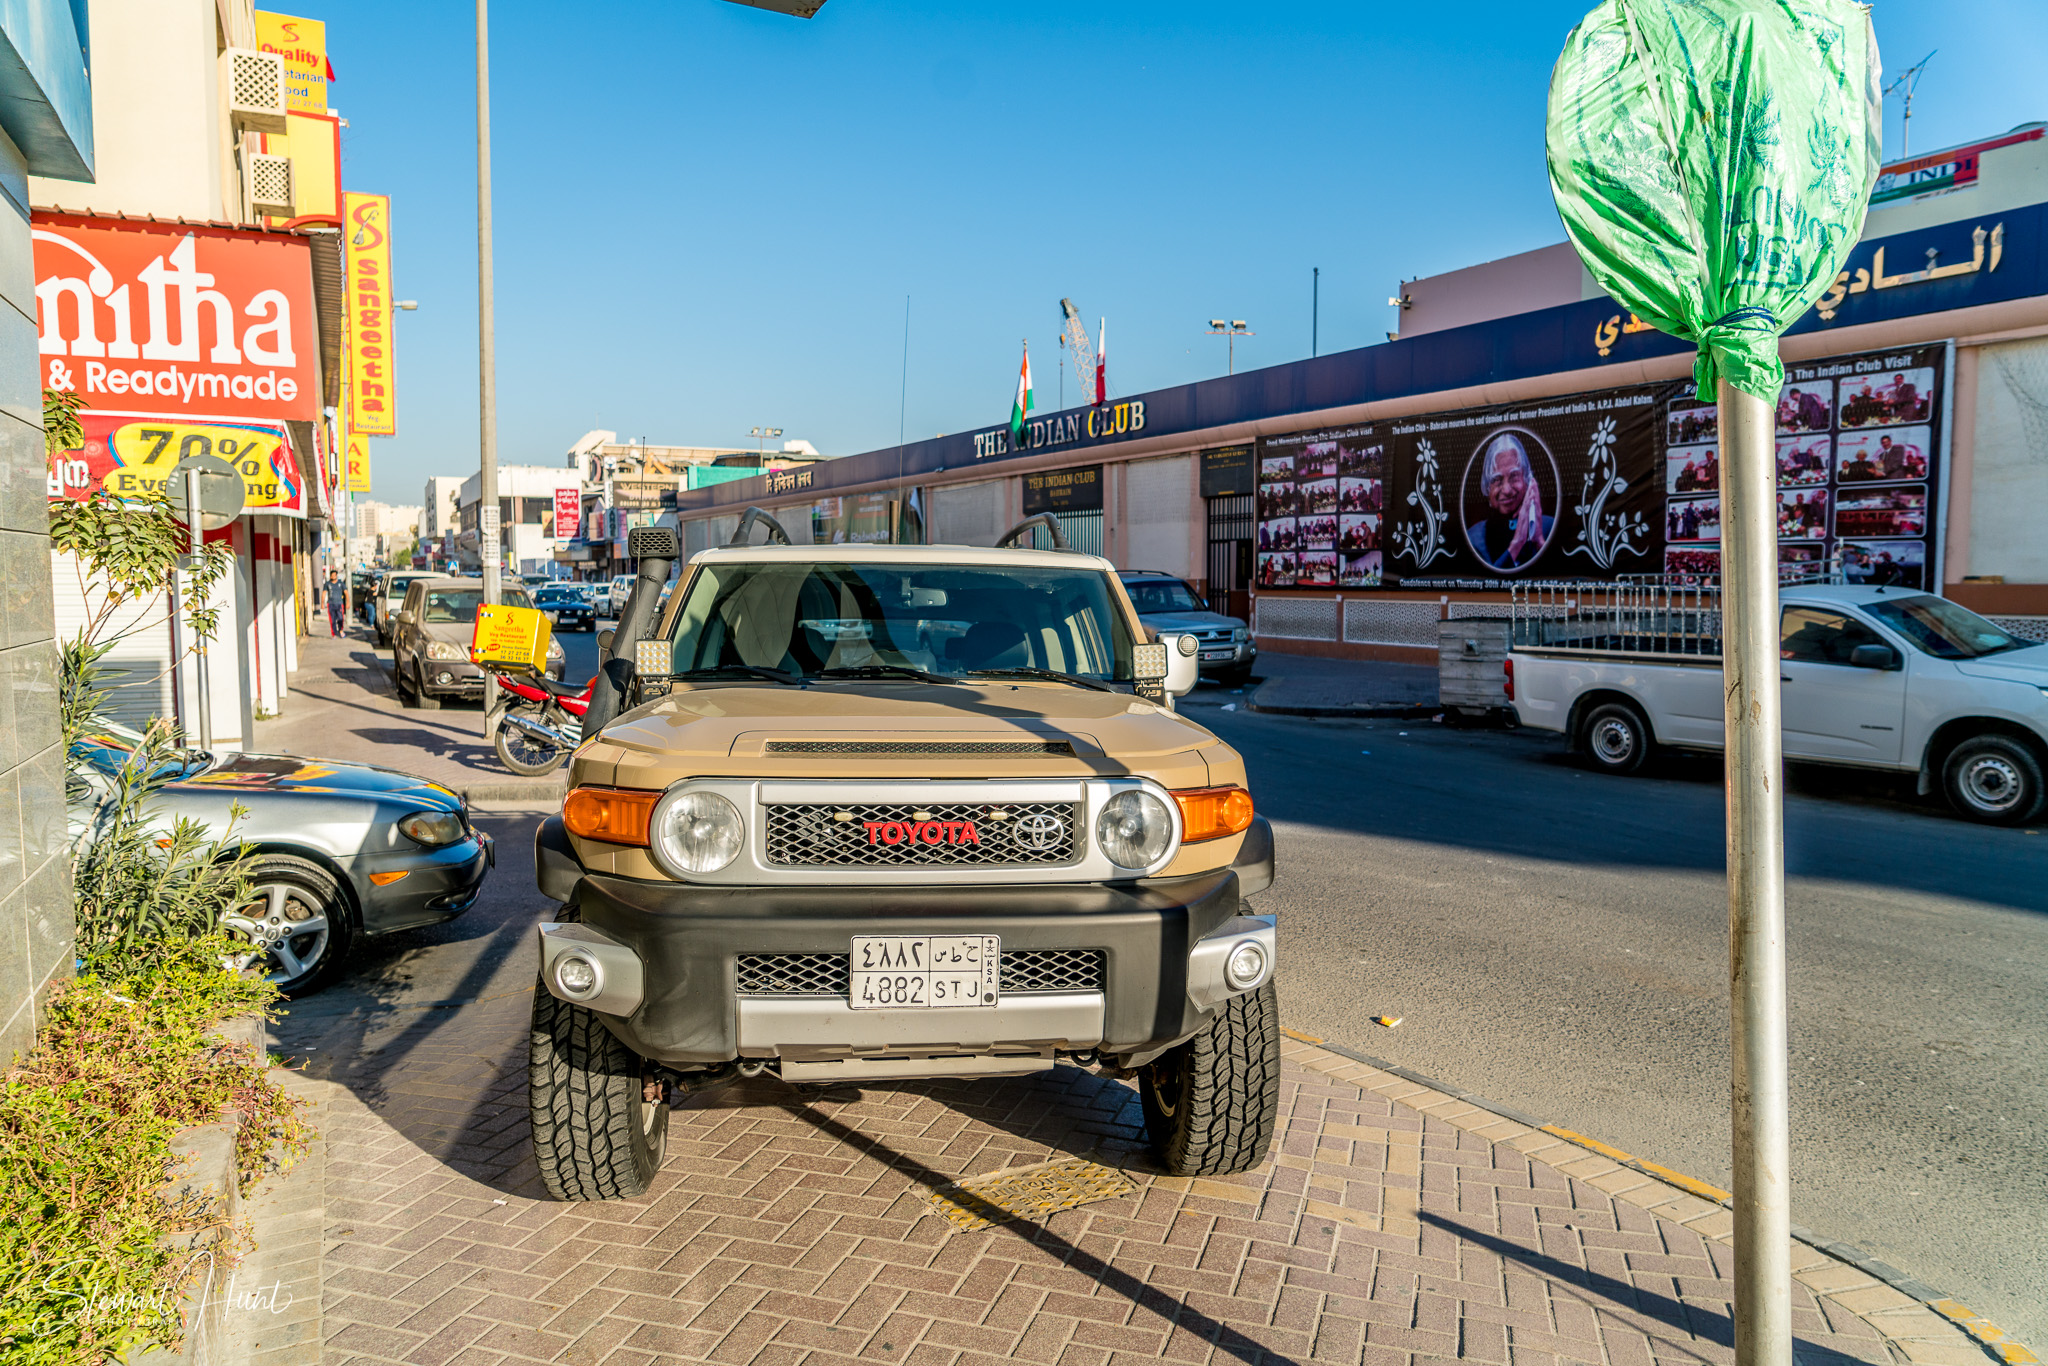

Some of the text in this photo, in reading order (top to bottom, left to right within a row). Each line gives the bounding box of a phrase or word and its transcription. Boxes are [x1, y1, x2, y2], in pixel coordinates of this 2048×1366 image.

[261, 43, 320, 68] Quality
[284, 69, 324, 83] etarian
[285, 87, 308, 97] ood
[1910, 157, 1933, 170] THE
[1910, 158, 1979, 185] INDI
[35, 230, 297, 369] nitha
[1795, 369, 1815, 380] The
[1818, 364, 1853, 377] Indian
[1855, 359, 1882, 373] Club
[1885, 355, 1912, 369] Visit
[48, 359, 298, 404] & Readymade
[1392, 427, 1400, 435] The
[1400, 426, 1414, 434] Indian
[1415, 424, 1426, 433] Club
[1430, 421, 1448, 431] Bahrain
[1448, 420, 1466, 428] mourns
[1467, 418, 1475, 426] the
[1475, 416, 1485, 425] sad
[1485, 415, 1503, 424] demise
[1519, 410, 1537, 419] former
[1538, 406, 1564, 417] President
[1565, 405, 1572, 414] of
[1572, 403, 1587, 413] India
[1588, 402, 1596, 411] Dr.
[1597, 400, 1614, 411] A.P.J.
[1614, 397, 1632, 408] Abdul
[1633, 395, 1653, 406] Kalam
[974, 400, 1147, 459] THE NDIAN CLUB
[1302, 435, 1318, 443] During
[1329, 431, 1346, 440] Indian
[1346, 429, 1359, 438] Club
[1360, 427, 1373, 435] Visit
[140, 429, 259, 476] 70%
[620, 482, 673, 491] WESTERN
[1028, 470, 1096, 490] THE INDIAN CLUB
[1399, 579, 1432, 587] Condolence
[1432, 579, 1447, 587] meet
[1456, 579, 1483, 589] Thursday
[1484, 580, 1499, 588] 30th
[1500, 580, 1513, 590] July
[494, 625, 524, 633] Sangeetha
[863, 821, 980, 845] TOYOTA
[863, 942, 924, 968] ٤٨٨٢
[862, 976, 924, 1004] 4882
